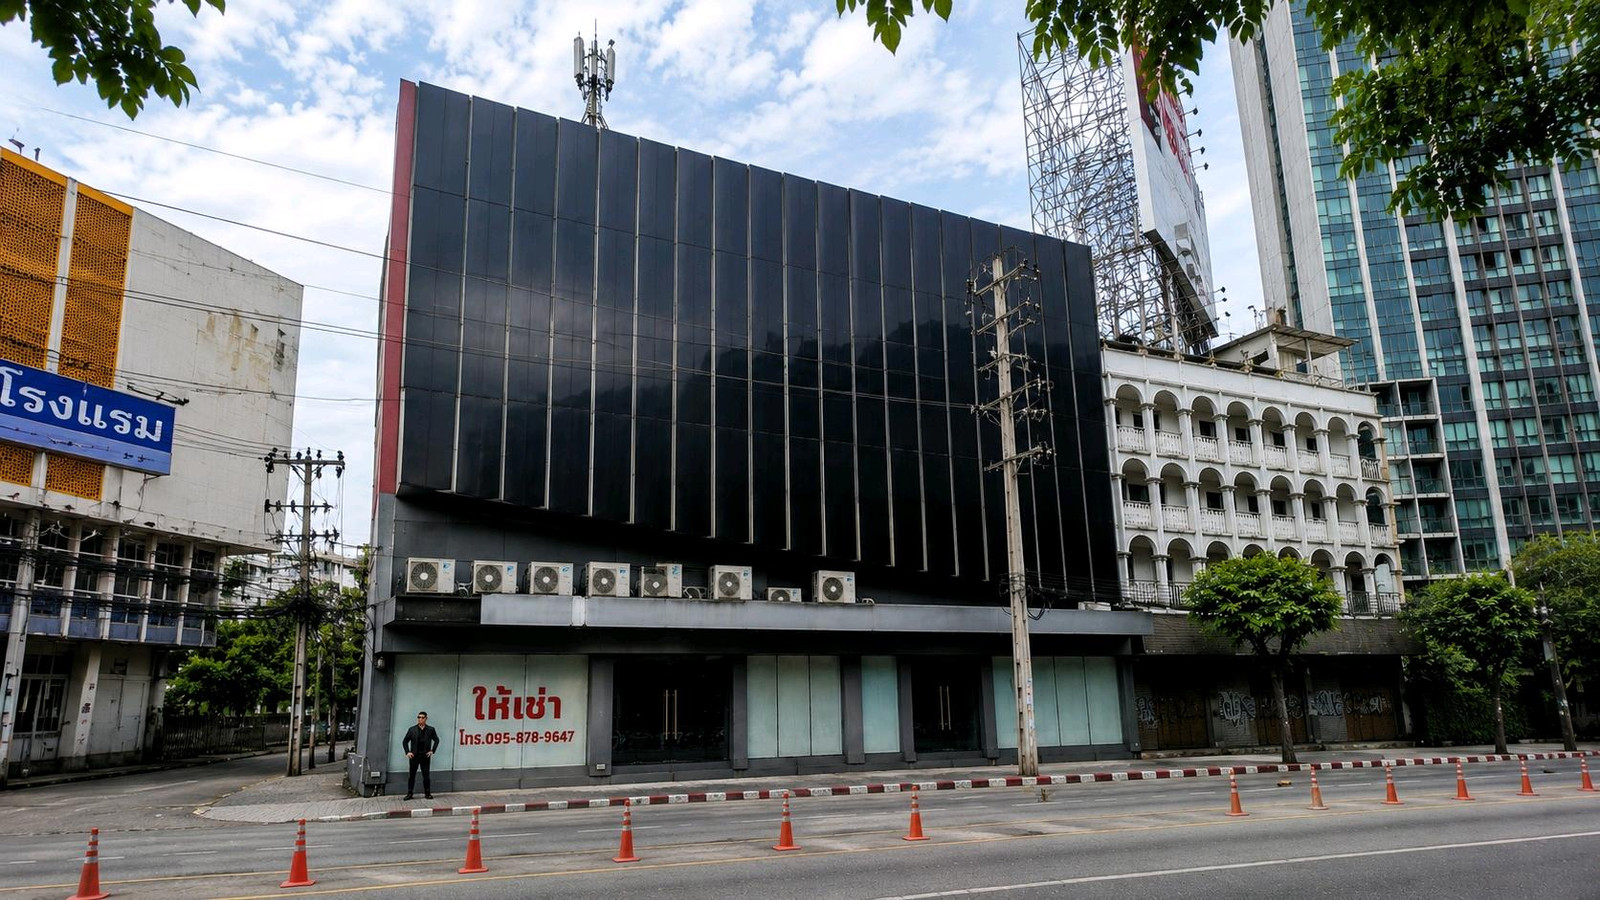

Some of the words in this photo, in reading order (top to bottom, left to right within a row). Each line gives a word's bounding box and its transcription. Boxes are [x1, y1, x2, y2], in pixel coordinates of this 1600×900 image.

[0, 366, 163, 442] โรงแรม
[472, 685, 562, 720] ให้เช่า
[460, 729, 575, 746] โทร.095-878-9647
